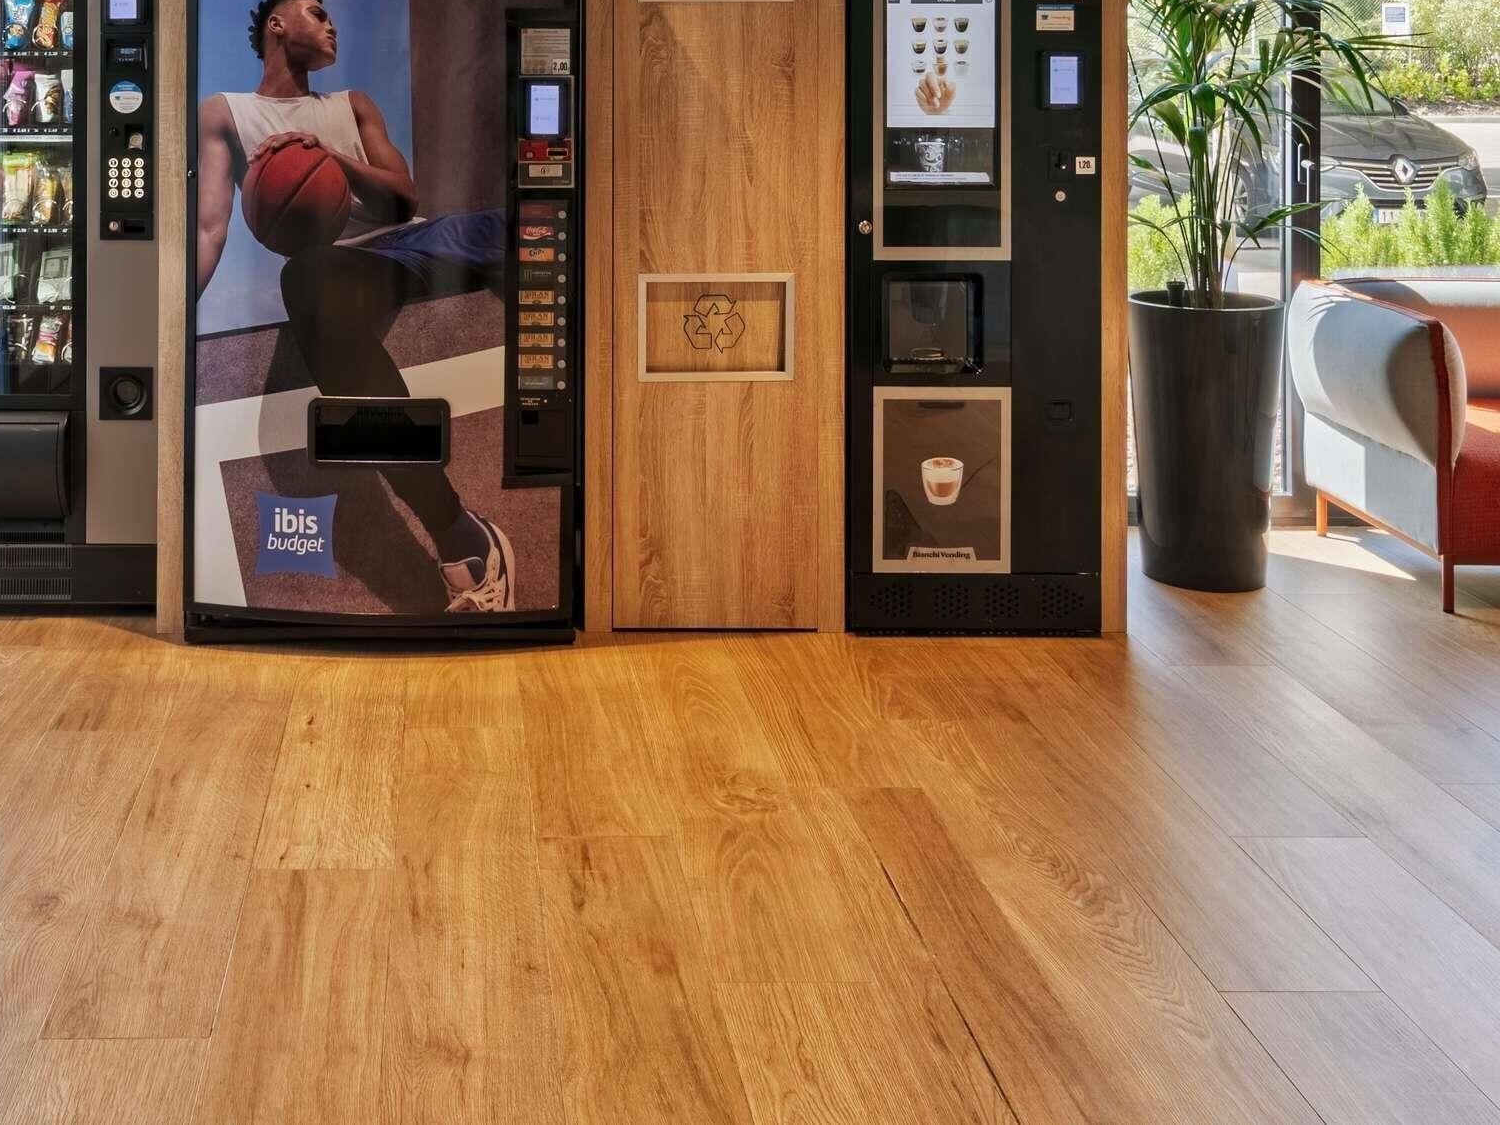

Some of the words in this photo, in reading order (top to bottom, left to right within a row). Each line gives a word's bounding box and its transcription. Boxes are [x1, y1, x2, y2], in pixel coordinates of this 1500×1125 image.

[274, 507, 318, 534] ibis
[267, 533, 325, 555] budget
[940, 551, 971, 560] Vending
